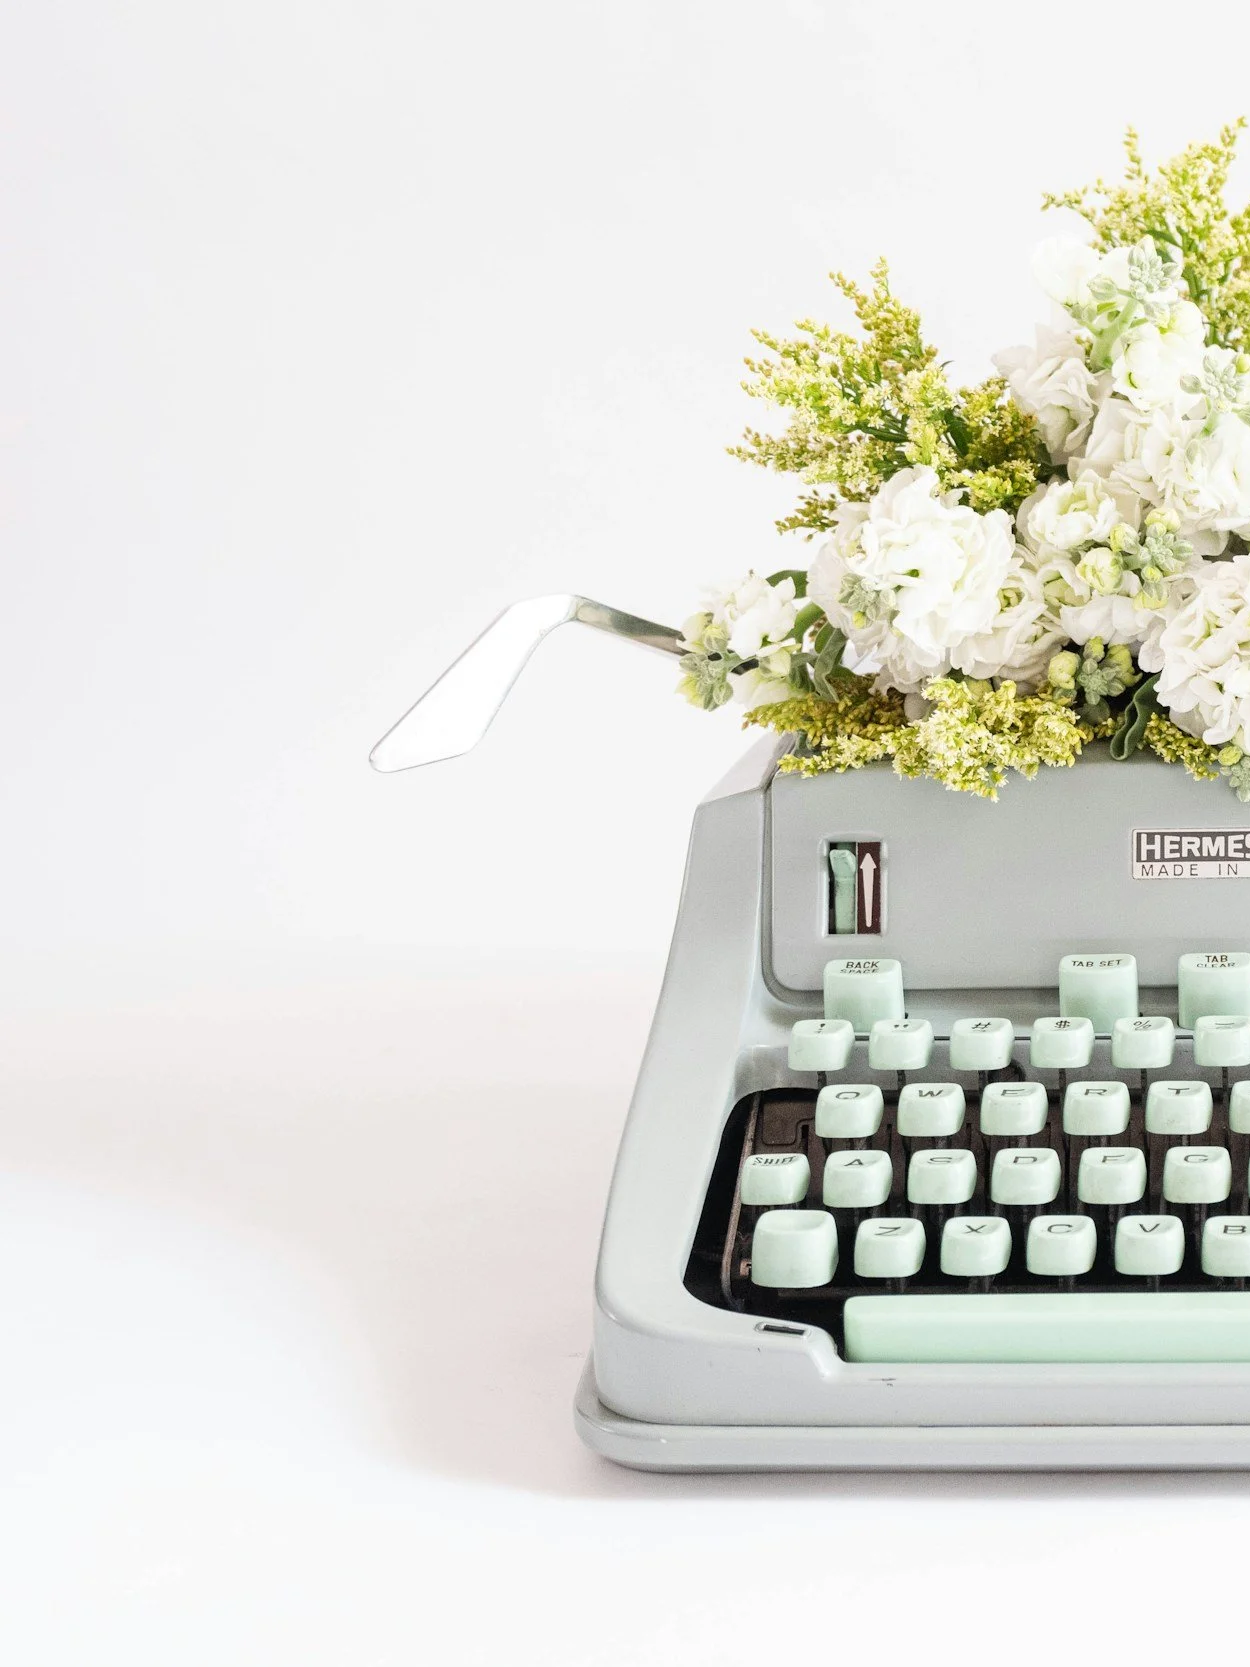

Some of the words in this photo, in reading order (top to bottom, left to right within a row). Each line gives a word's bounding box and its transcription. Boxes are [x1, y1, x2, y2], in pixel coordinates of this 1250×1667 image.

[1140, 863, 1199, 877] MADE
[1217, 863, 1239, 876] IN
[1204, 954, 1229, 963] TAB
[845, 960, 880, 969] BACK
[1071, 959, 1094, 968] TAB
[1099, 959, 1123, 968] SET
[918, 1089, 944, 1098] W
[1000, 1088, 1025, 1097] E
[1083, 1088, 1108, 1096] R
[1167, 1087, 1190, 1096] T
[843, 1158, 864, 1167] A
[928, 1156, 953, 1165] S
[1012, 1155, 1038, 1164] D
[1101, 1154, 1125, 1164] F
[1183, 1154, 1209, 1163] G
[874, 1226, 902, 1237] Z
[965, 1224, 987, 1234] X
[1046, 1223, 1074, 1234] C
[1138, 1223, 1161, 1233] V
[1222, 1224, 1247, 1234] B
